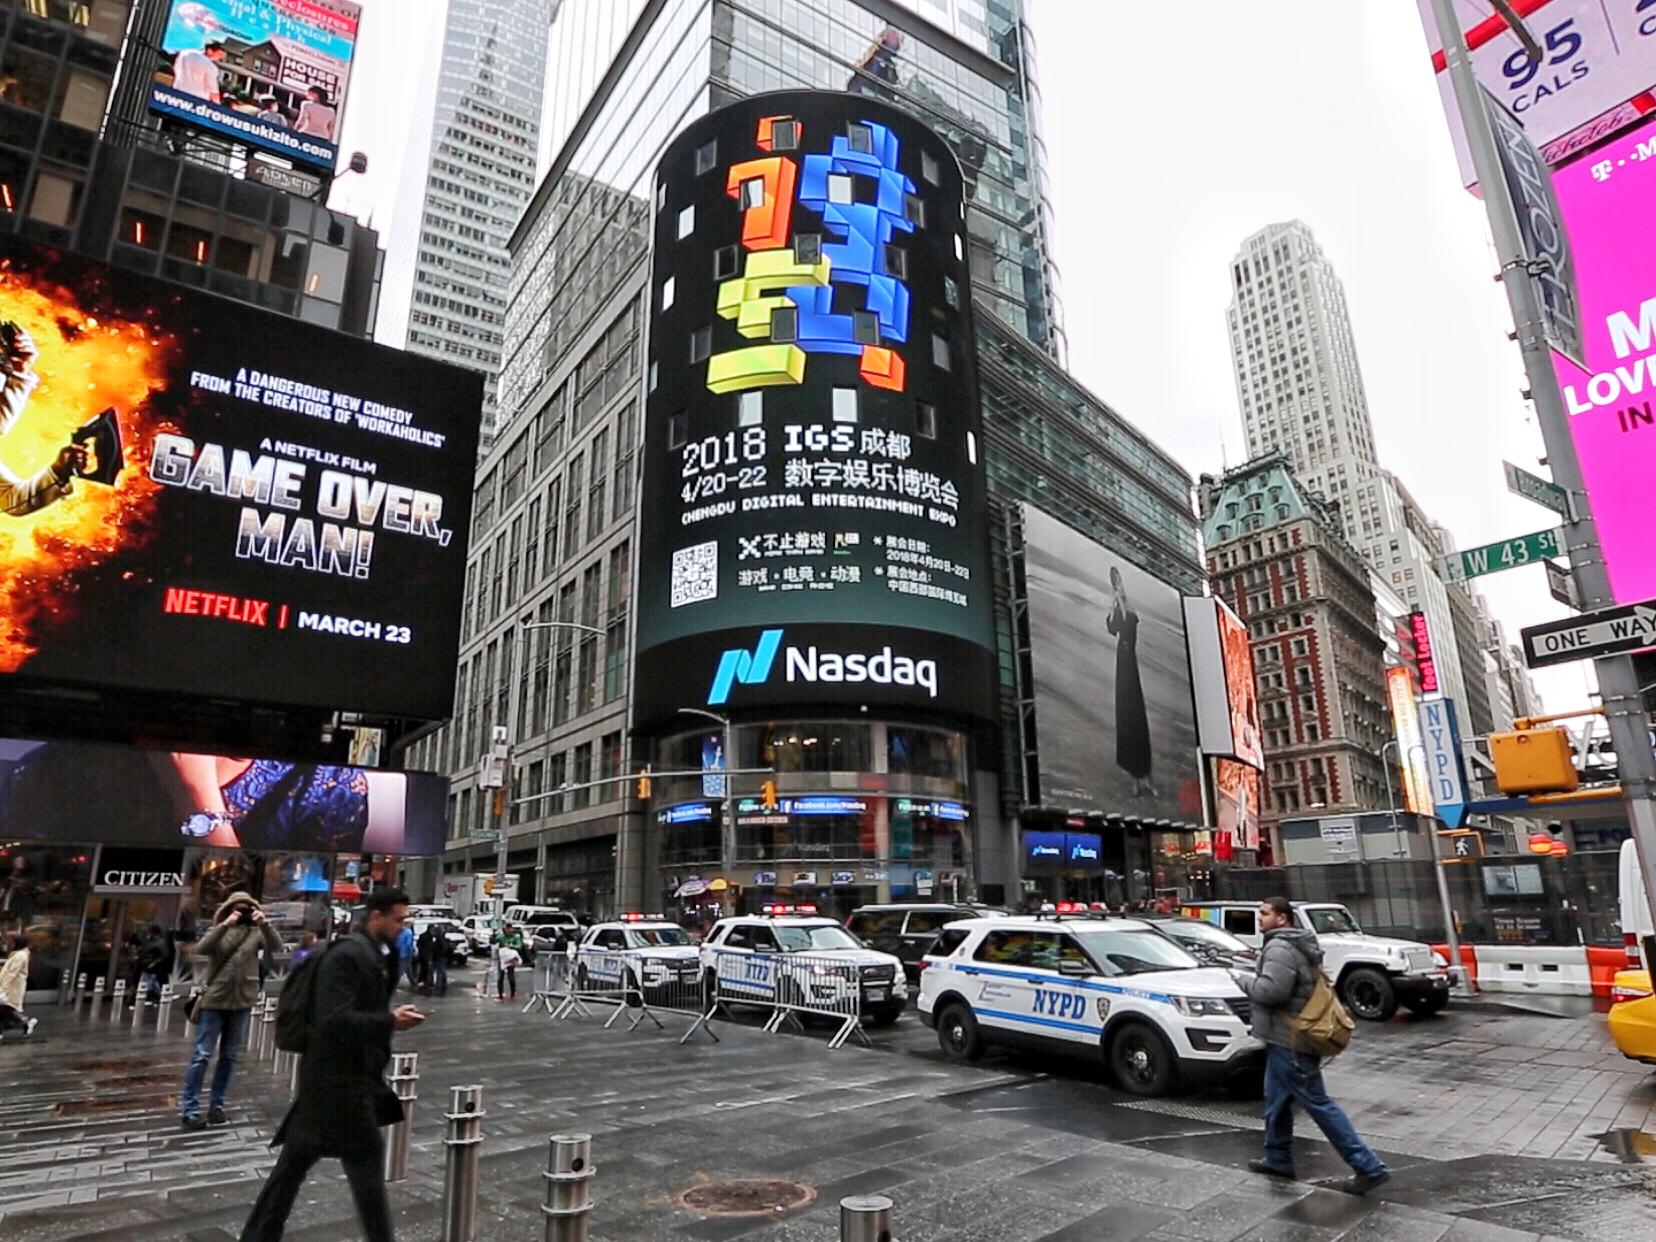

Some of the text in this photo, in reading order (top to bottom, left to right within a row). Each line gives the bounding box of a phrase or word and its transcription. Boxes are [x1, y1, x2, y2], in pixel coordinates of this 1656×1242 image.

[284, 57, 337, 83] HOUSE
[284, 69, 308, 84] FOR
[1502, 18, 1582, 91] 95
[1510, 59, 1591, 114] CALS
[190, 370, 231, 395] FROM
[235, 382, 260, 402] THE
[263, 388, 339, 420] CREATORS
[335, 406, 353, 424] OF
[236, 367, 413, 426] A DANGEROUS NEW COMEDY
[1617, 401, 1655, 433] IN
[260, 437, 377, 476] A NETFLIX FILM
[682, 426, 767, 478] 2018
[784, 423, 911, 461] IGS 成都
[149, 432, 453, 547] GAME OVER,
[681, 465, 768, 504] 4/20-22
[784, 457, 960, 511] 数字娱乐博览会
[681, 493, 958, 528] CHENGDU DIGITAL ENTERTAINMENT EXPO
[235, 506, 375, 580] MAN!
[1467, 531, 1556, 575] W 43 St
[164, 587, 412, 644] NETFLIX MARCH 23
[1544, 616, 1656, 653] ONE WAY
[785, 646, 938, 698] Nasdaq
[1425, 703, 1454, 801] NYPD
[103, 870, 187, 887] CITIZEN
[1032, 988, 1087, 1020] NYPD
